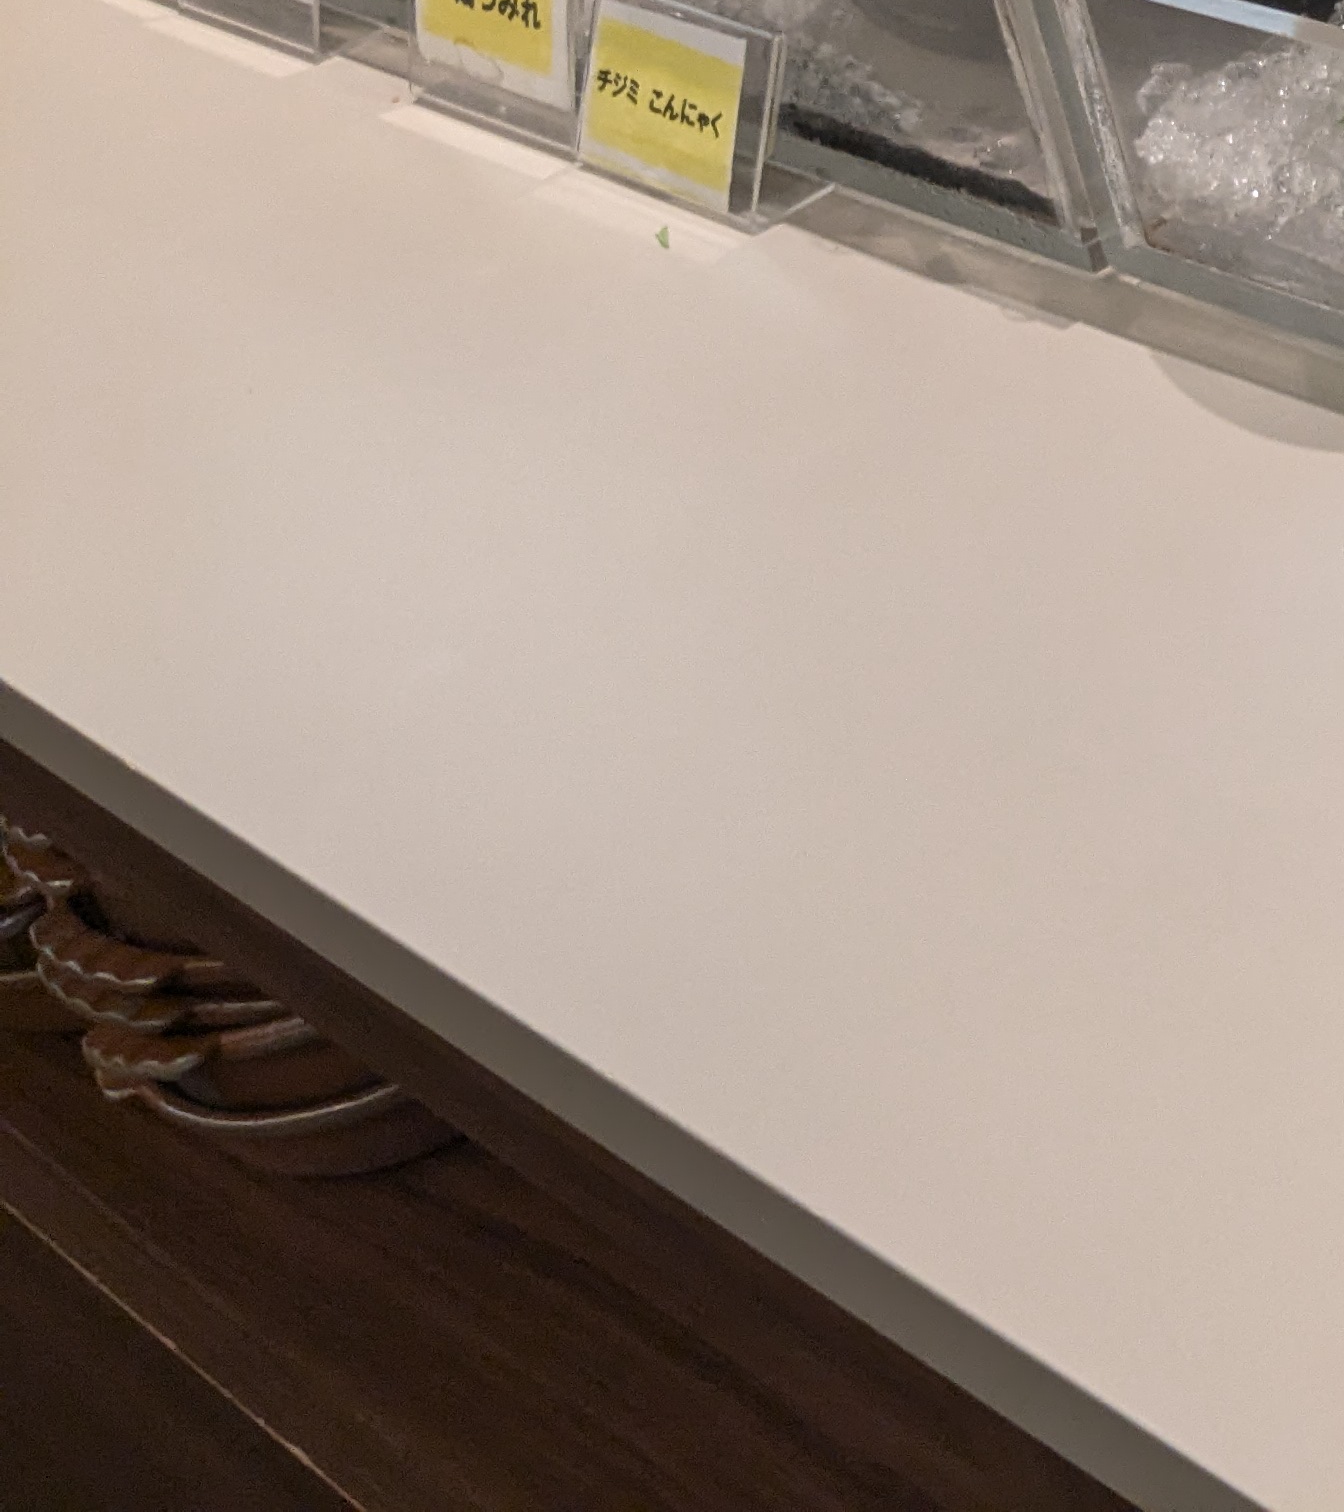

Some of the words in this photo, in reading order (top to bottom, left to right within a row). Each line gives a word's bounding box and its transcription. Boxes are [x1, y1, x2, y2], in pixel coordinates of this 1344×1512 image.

[596, 69, 640, 105] チジミ
[649, 88, 723, 139] こんにゃく
